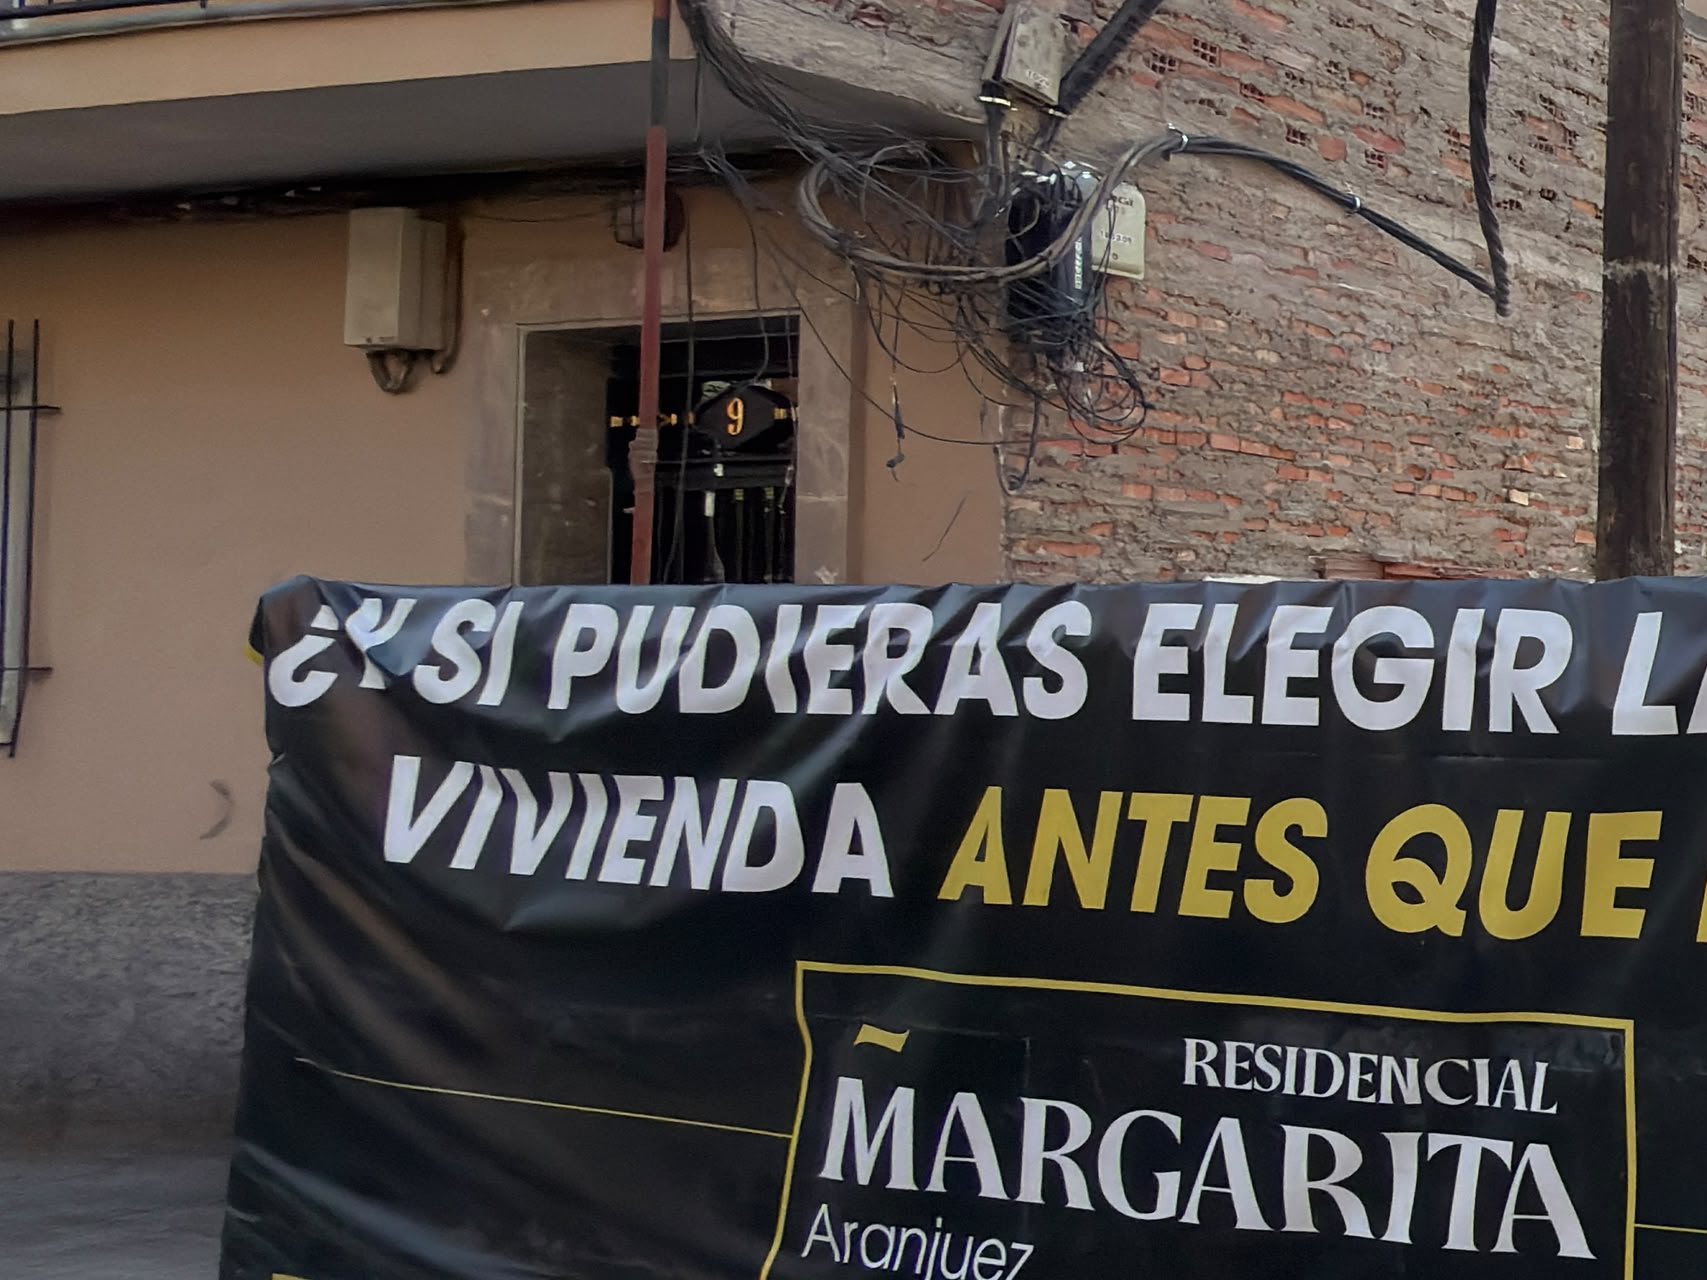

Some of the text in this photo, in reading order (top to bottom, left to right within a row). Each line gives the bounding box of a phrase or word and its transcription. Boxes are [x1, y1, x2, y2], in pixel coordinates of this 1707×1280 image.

[726, 396, 744, 436] 9
[413, 598, 524, 706] SI
[548, 600, 1093, 719] PUDIERAS
[1132, 602, 1573, 733] ELEGIR
[384, 755, 893, 897] VIVIENDA
[938, 786, 1327, 923] ANTES
[1366, 804, 1662, 939] QUE
[1184, 1039, 1557, 1113] RESIDENCIAL
[816, 1075, 1597, 1261] MARGARITA
